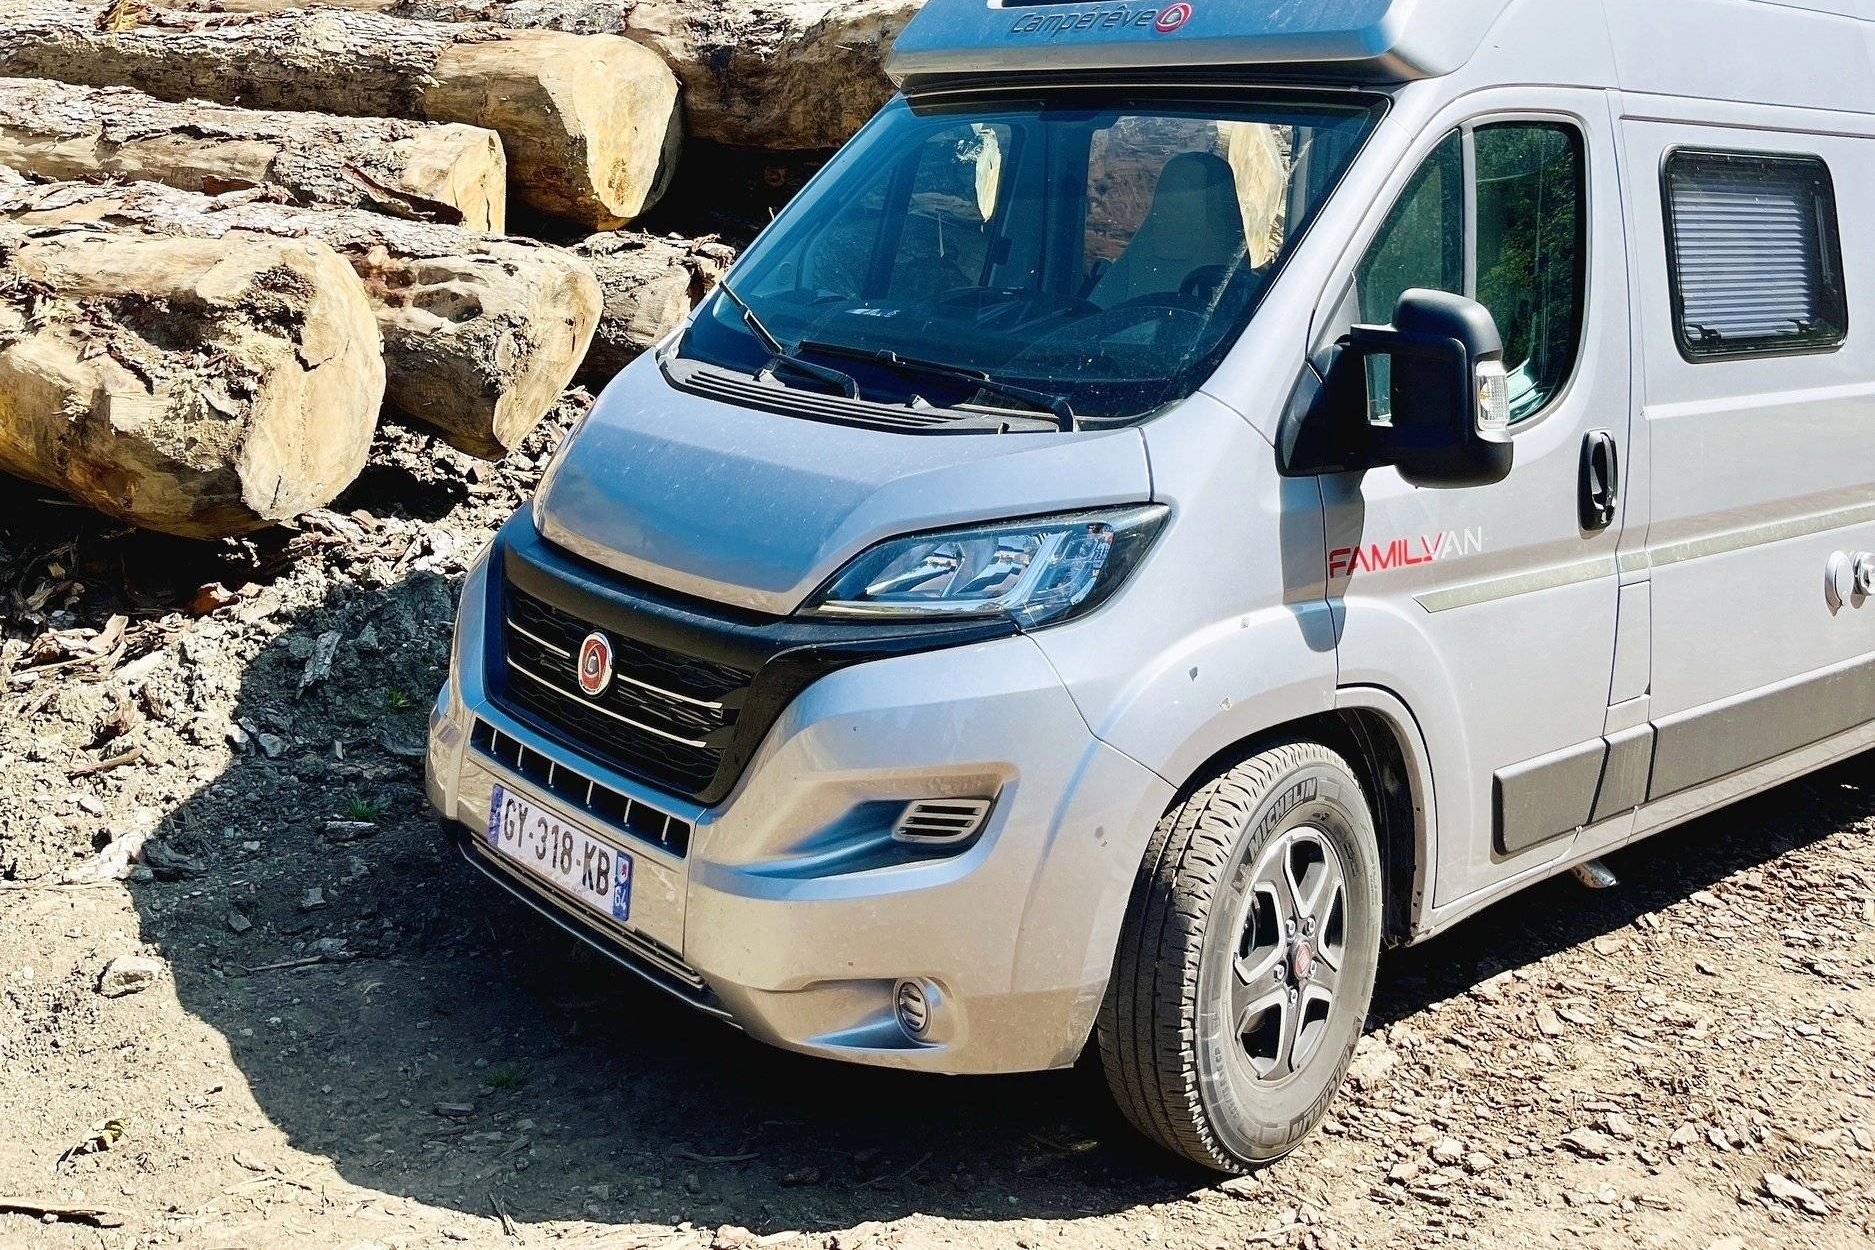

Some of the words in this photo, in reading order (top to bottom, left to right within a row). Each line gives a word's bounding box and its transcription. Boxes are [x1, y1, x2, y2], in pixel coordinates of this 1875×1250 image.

[504, 798, 610, 896] GY-318-KB
[614, 887, 627, 910] 64
[1250, 777, 1317, 860] MICHELIN
